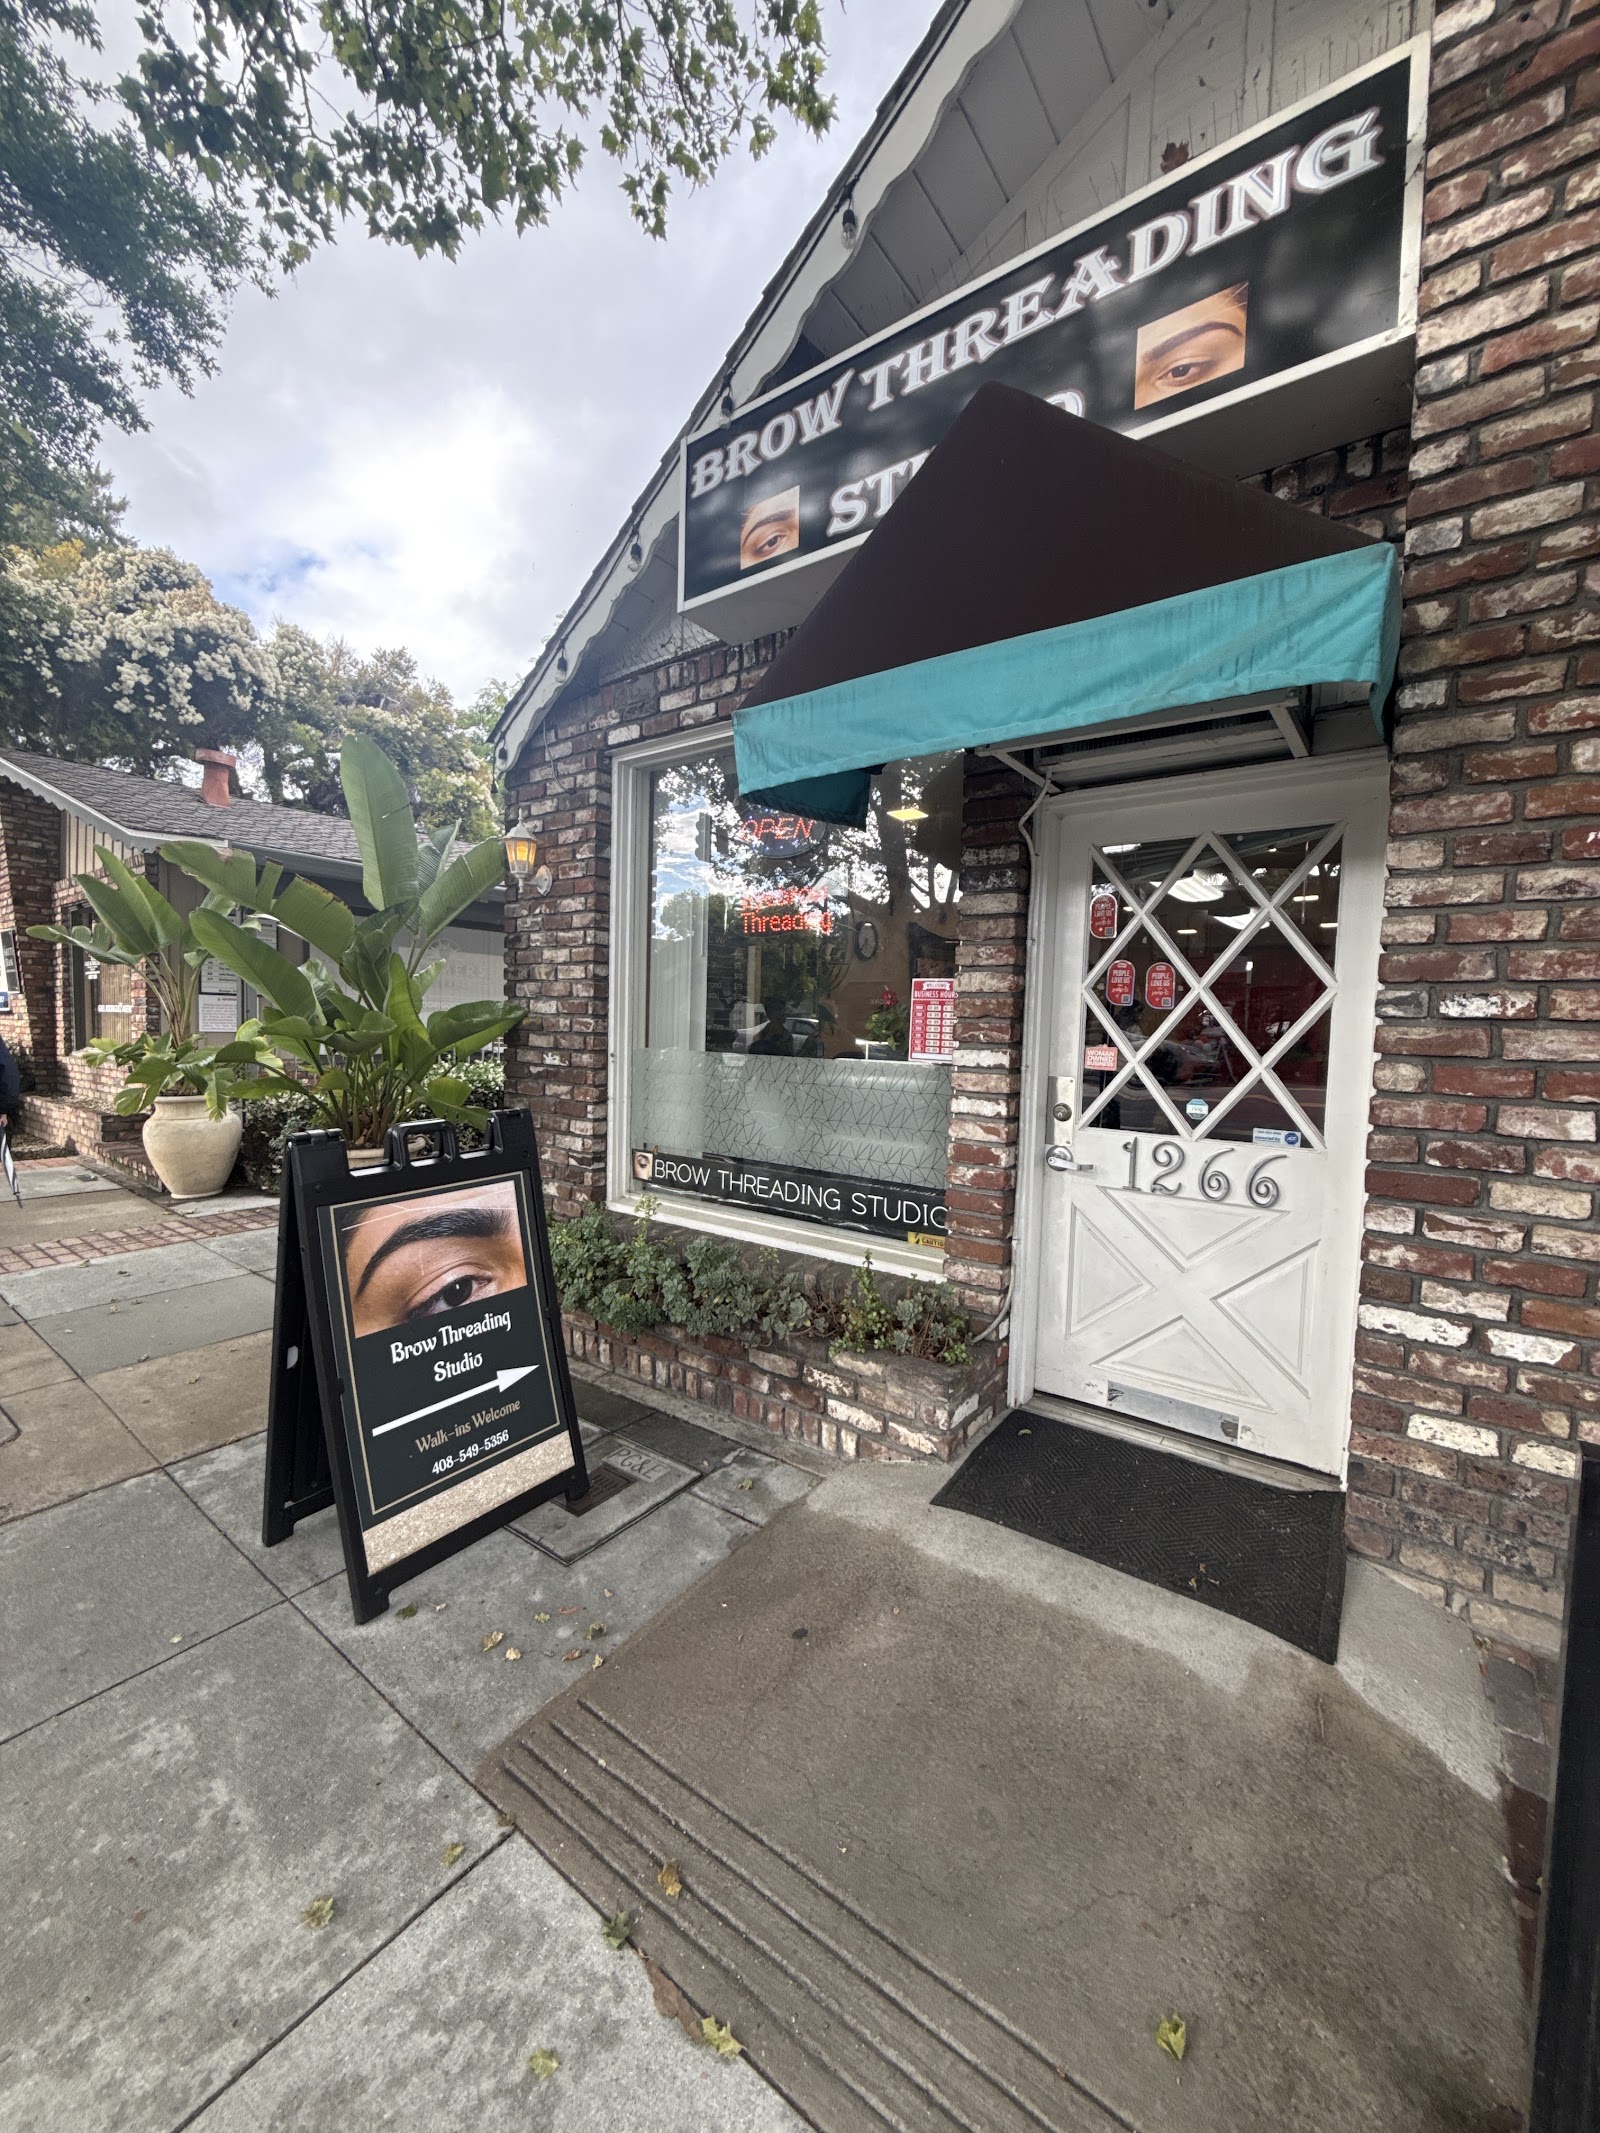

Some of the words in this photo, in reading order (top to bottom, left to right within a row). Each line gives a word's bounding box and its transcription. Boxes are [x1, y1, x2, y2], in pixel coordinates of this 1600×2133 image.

[690, 368, 855, 498] BROW
[860, 107, 1385, 411] THREADING
[741, 816, 814, 841] OPEN
[914, 990, 939, 998] BUSINESS
[940, 990, 958, 999] HOURS
[655, 1159, 710, 1187] BROW
[717, 1169, 841, 1211] THREADING
[1122, 1137, 1287, 1208] 1266
[390, 1337, 437, 1364] Brow
[438, 1311, 512, 1347] Threading
[433, 1352, 483, 1382] Studio
[415, 1422, 472, 1453] Walk-ins
[471, 1400, 521, 1428] Welcome
[431, 1429, 510, 1475] 408-549-5356
[608, 1446, 669, 1480] PG&E
